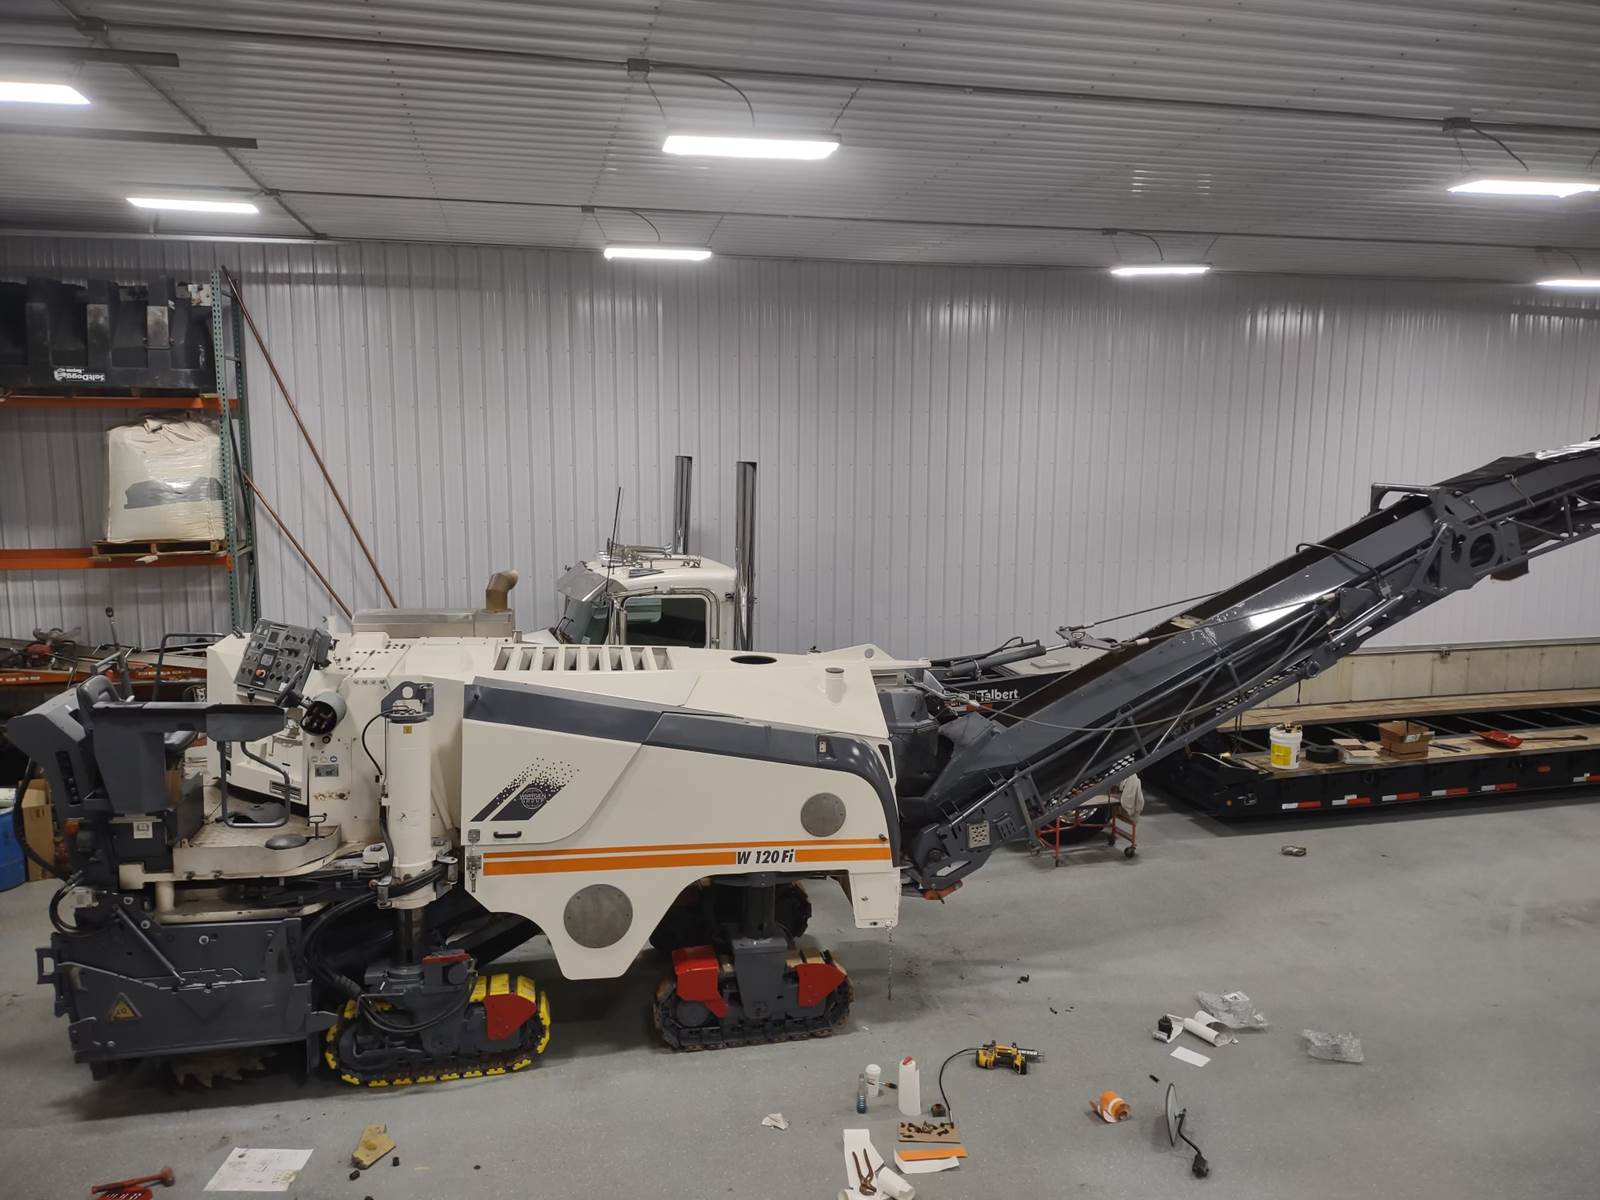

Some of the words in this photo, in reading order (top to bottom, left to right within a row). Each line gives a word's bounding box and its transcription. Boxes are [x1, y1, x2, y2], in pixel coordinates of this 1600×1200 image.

[976, 689, 1018, 702] Talbert
[737, 850, 752, 865] W
[755, 850, 780, 864] 120
[781, 848, 795, 863] Fi
